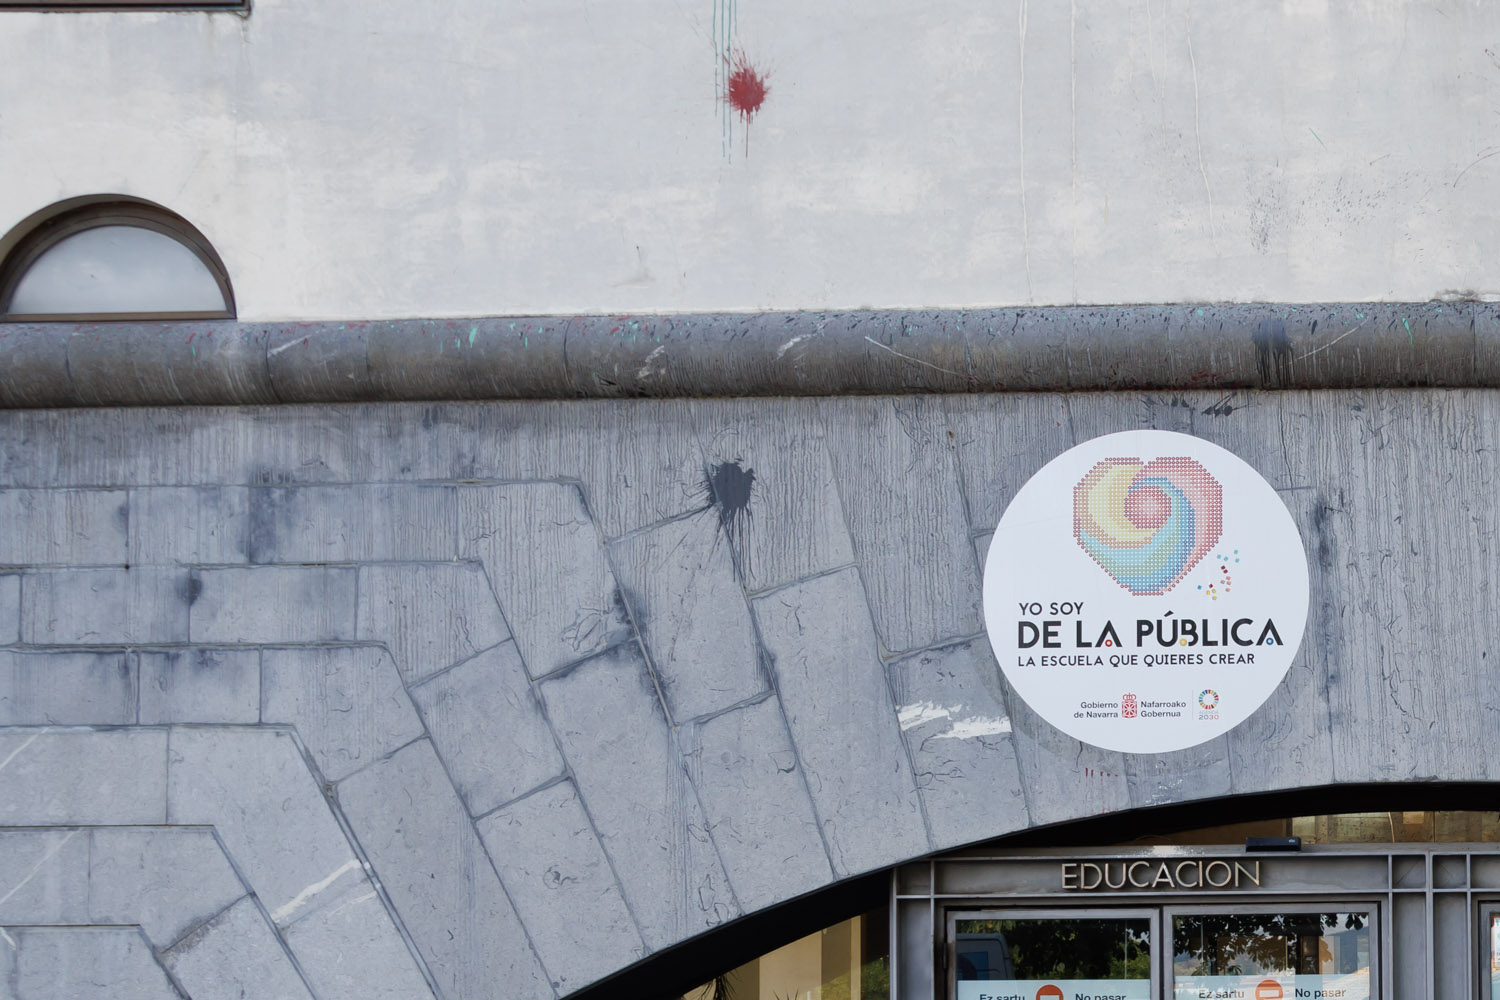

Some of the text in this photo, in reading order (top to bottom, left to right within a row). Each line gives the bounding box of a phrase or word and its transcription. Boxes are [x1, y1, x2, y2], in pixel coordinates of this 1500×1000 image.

[1018, 602, 1084, 616] YO SOY
[1018, 610, 1284, 649] DE LA PÚBLICA
[1018, 653, 1255, 667] LA ESCUELA QUE QUIERES CREAR
[1080, 701, 1118, 709] Gobierno
[1140, 700, 1187, 708] Nafarroako
[1073, 711, 1119, 719] de Navarra
[1140, 710, 1181, 718] Gobernua
[1060, 860, 1261, 891] EDUCACION
[1198, 989, 1245, 999] Ez sartu
[1294, 988, 1347, 1000] No pasar
